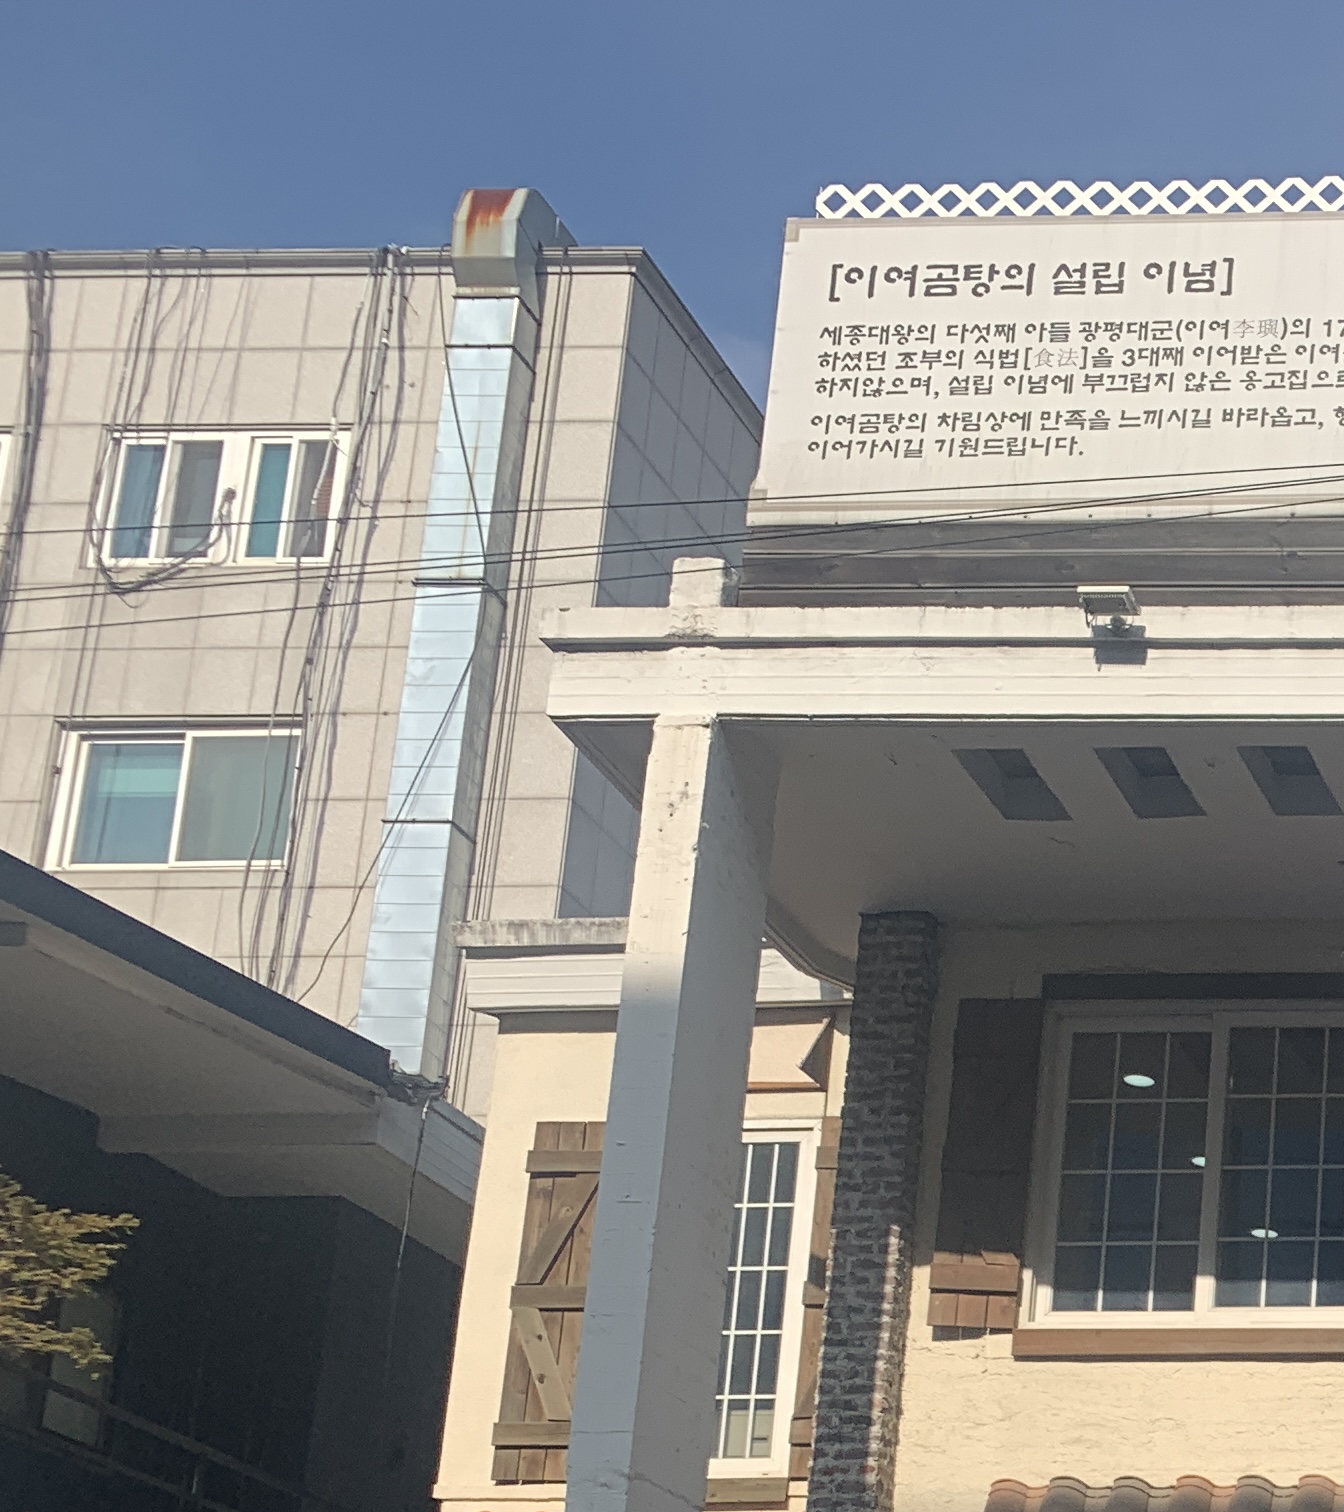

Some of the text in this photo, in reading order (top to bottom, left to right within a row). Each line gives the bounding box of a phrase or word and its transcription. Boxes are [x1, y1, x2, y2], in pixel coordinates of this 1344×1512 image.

[828, 257, 1235, 302] [이여곰탕의 설립 이념]
[819, 323, 936, 346] 세종대왕의
[946, 323, 1016, 344] 다섯째
[1025, 322, 1071, 343] 아들
[818, 351, 886, 371] 하셨던
[895, 349, 964, 370] 조부의
[1121, 346, 1184, 367] 3대째
[1192, 344, 1287, 366] 이어받은
[815, 375, 940, 399] 하지않으며,
[948, 375, 993, 396] 설립
[1004, 374, 1074, 395] 이념에
[1082, 372, 1175, 394] 부끄럽지
[1185, 371, 1231, 393] 않은
[810, 412, 927, 435] 이여곰탕의
[937, 411, 1032, 433] 차림상에
[1040, 409, 1111, 432] 만족을
[1118, 408, 1211, 430] 느끼시길
[1222, 406, 1324, 430] 바라옵고,
[808, 436, 1084, 460] 이어가시길 기원드립니다.
